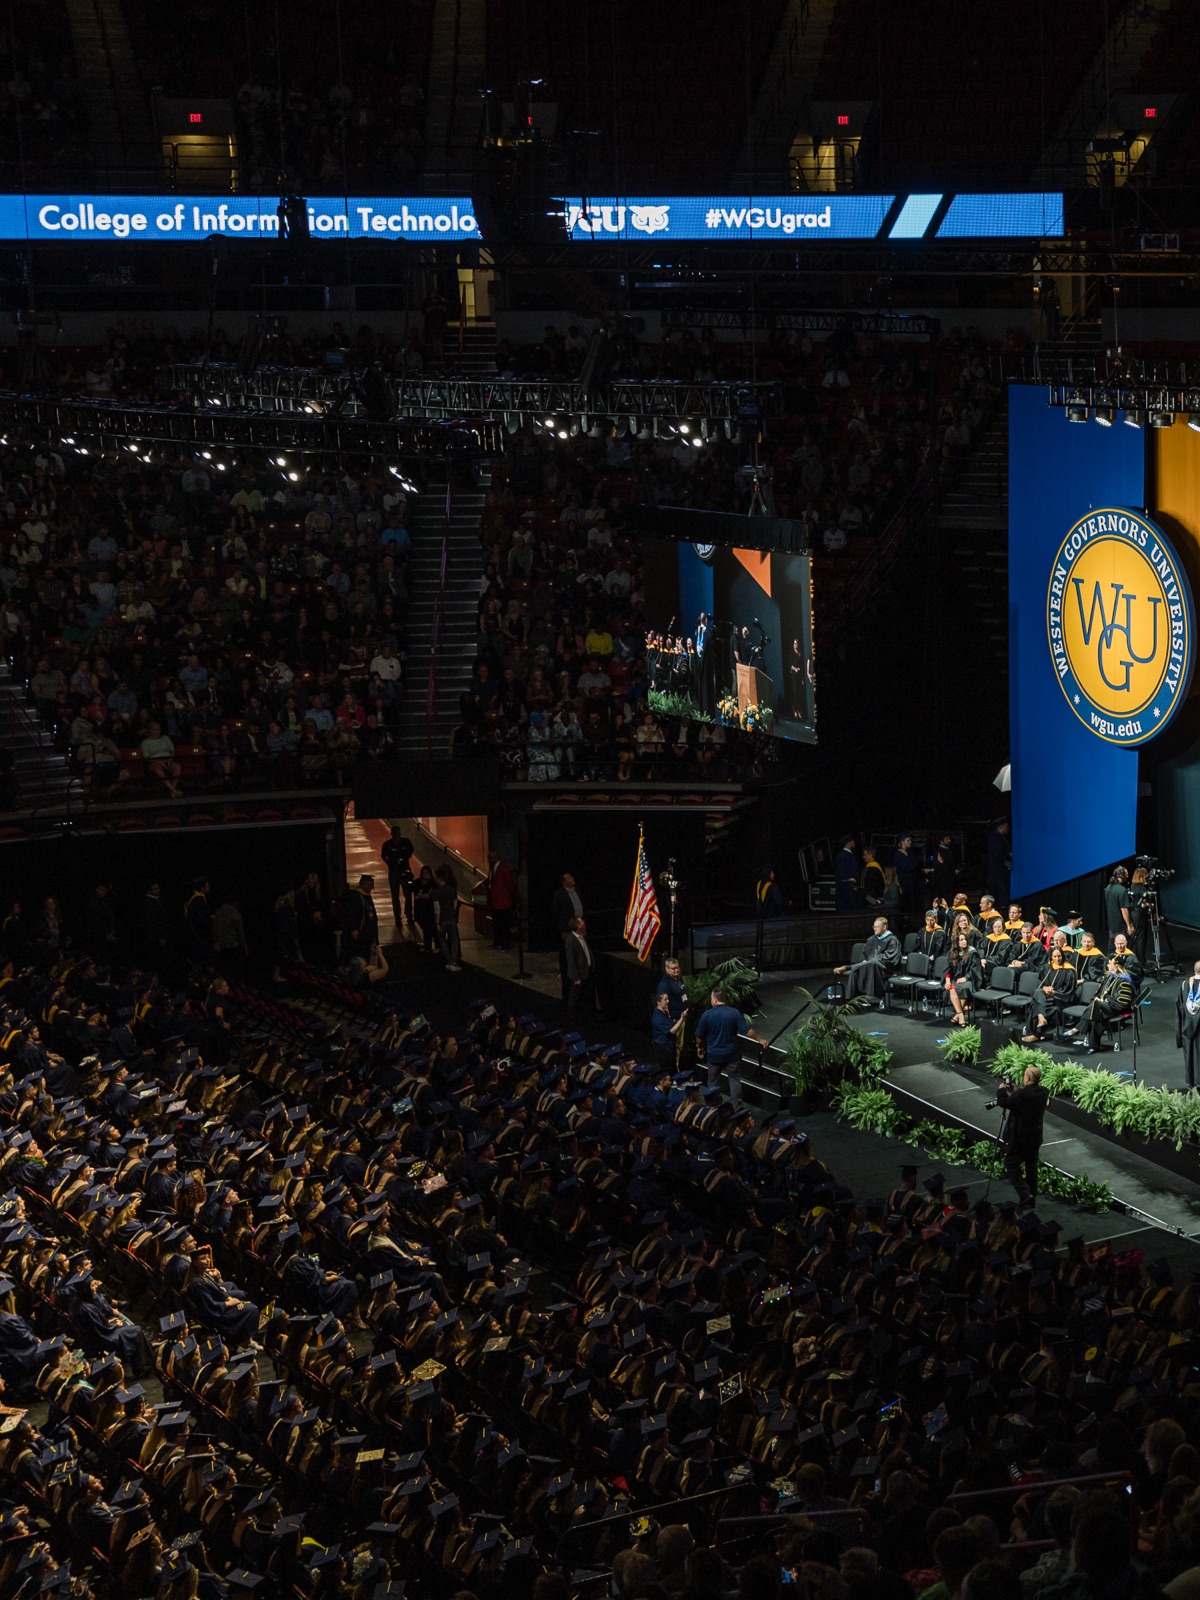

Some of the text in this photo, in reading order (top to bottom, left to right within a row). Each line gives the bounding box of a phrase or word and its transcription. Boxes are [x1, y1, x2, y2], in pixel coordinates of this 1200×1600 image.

[189, 113, 202, 123] EXIT
[837, 115, 849, 125] EXIT
[1145, 107, 1156, 118] EXIT
[39, 204, 481, 237] College of Informion Technolo
[705, 206, 831, 233] #WGUgrad
[1064, 514, 1149, 561] GOVERNORS
[1050, 563, 1069, 679] WESTERN
[1151, 543, 1183, 694] UNIVERSITY
[1071, 577, 1162, 692] WGU
[1090, 711, 1143, 737] wgu.edu
